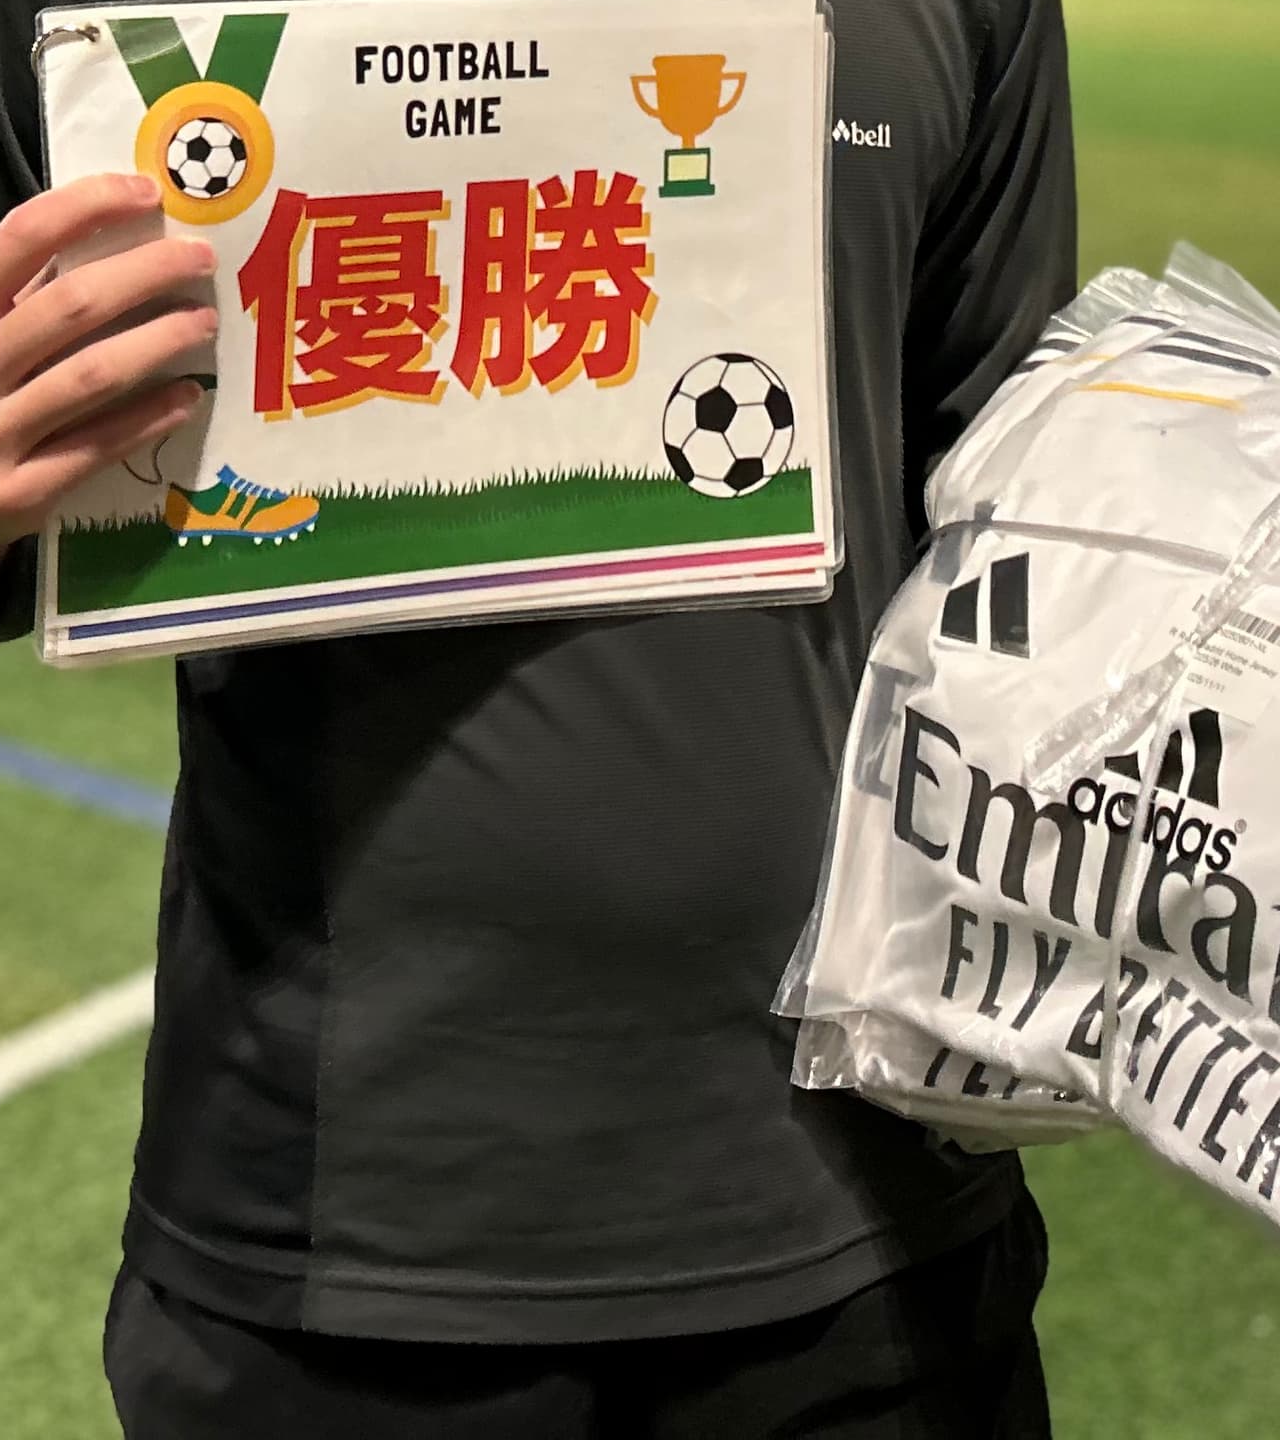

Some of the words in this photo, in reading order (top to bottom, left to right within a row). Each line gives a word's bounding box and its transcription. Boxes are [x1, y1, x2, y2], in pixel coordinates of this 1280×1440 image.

[354, 40, 549, 86] FOOTBALL
[405, 96, 502, 139] GAME
[851, 120, 891, 148] bell
[237, 168, 658, 422] 優勝
[1067, 777, 1238, 872] adidas
[940, 904, 1073, 1032] FLY
